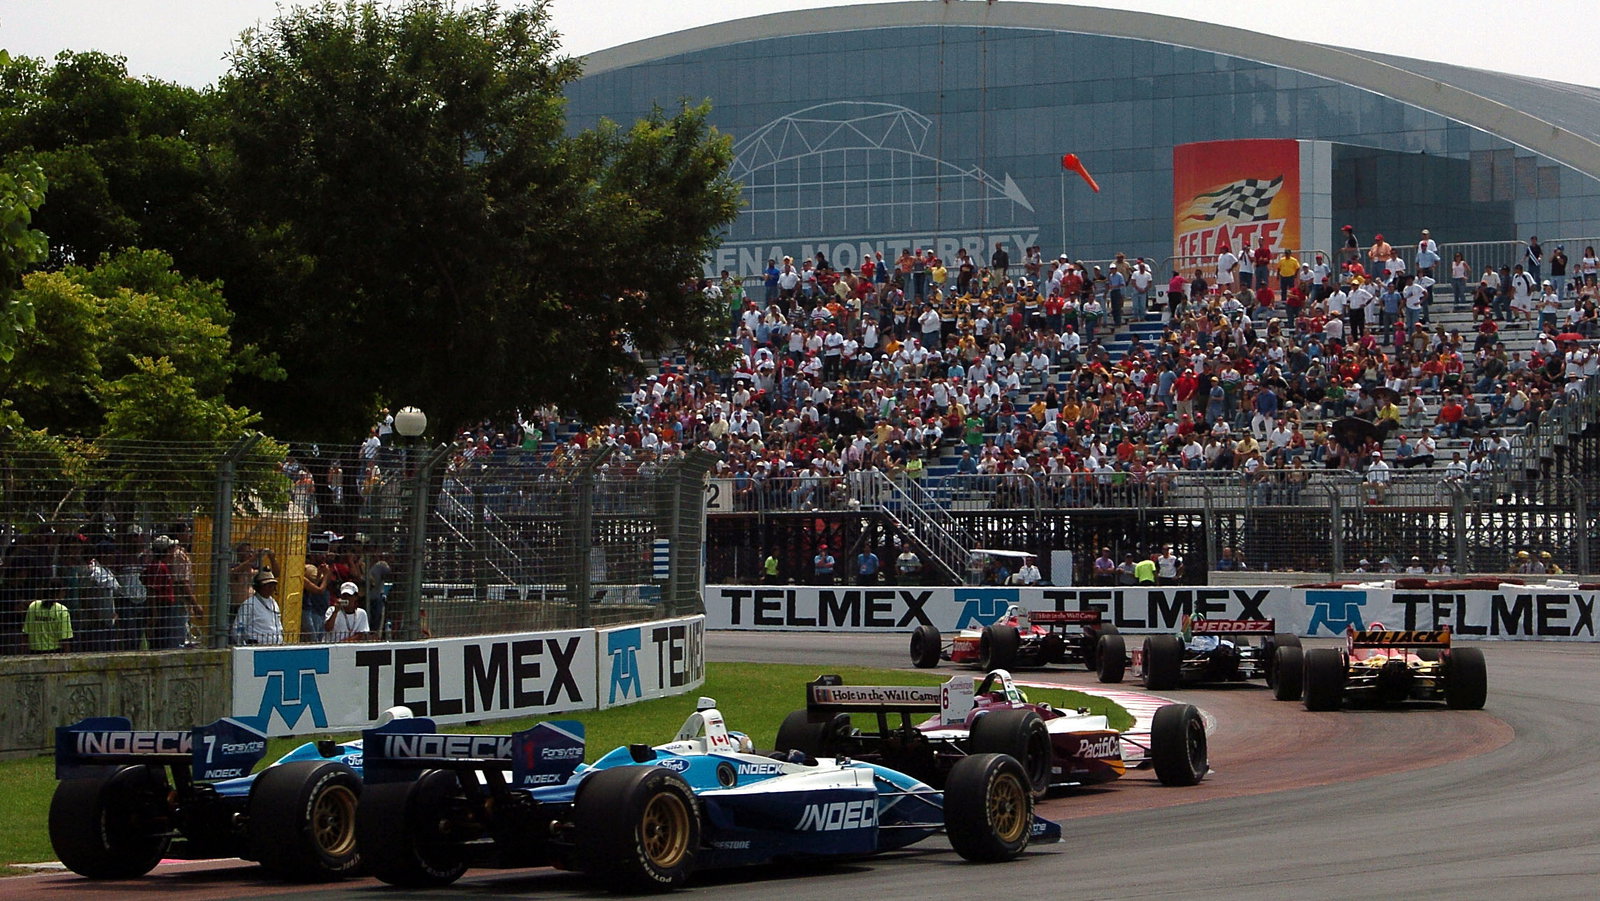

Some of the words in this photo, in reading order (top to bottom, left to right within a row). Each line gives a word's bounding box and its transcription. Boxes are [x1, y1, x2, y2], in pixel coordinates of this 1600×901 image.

[801, 234, 1039, 275] MONTERREY
[1179, 219, 1285, 269] TECATE
[721, 589, 933, 628] TELMEX
[1043, 589, 1269, 629] TELMEX
[1393, 594, 1595, 636] TELMEX
[1193, 622, 1271, 632] HERDEZ
[1356, 631, 1441, 642] MI-JACK
[356, 637, 583, 720] TELMEX
[832, 690, 855, 701] Hole
[856, 690, 867, 700] in
[868, 689, 884, 700] the
[885, 690, 908, 701] Wall
[910, 691, 941, 704] Camp
[943, 687, 949, 709] 6
[203, 735, 216, 763] 7
[221, 741, 265, 752] Forsythe
[541, 747, 583, 757] Forsythe
[662, 758, 683, 772] Ford
